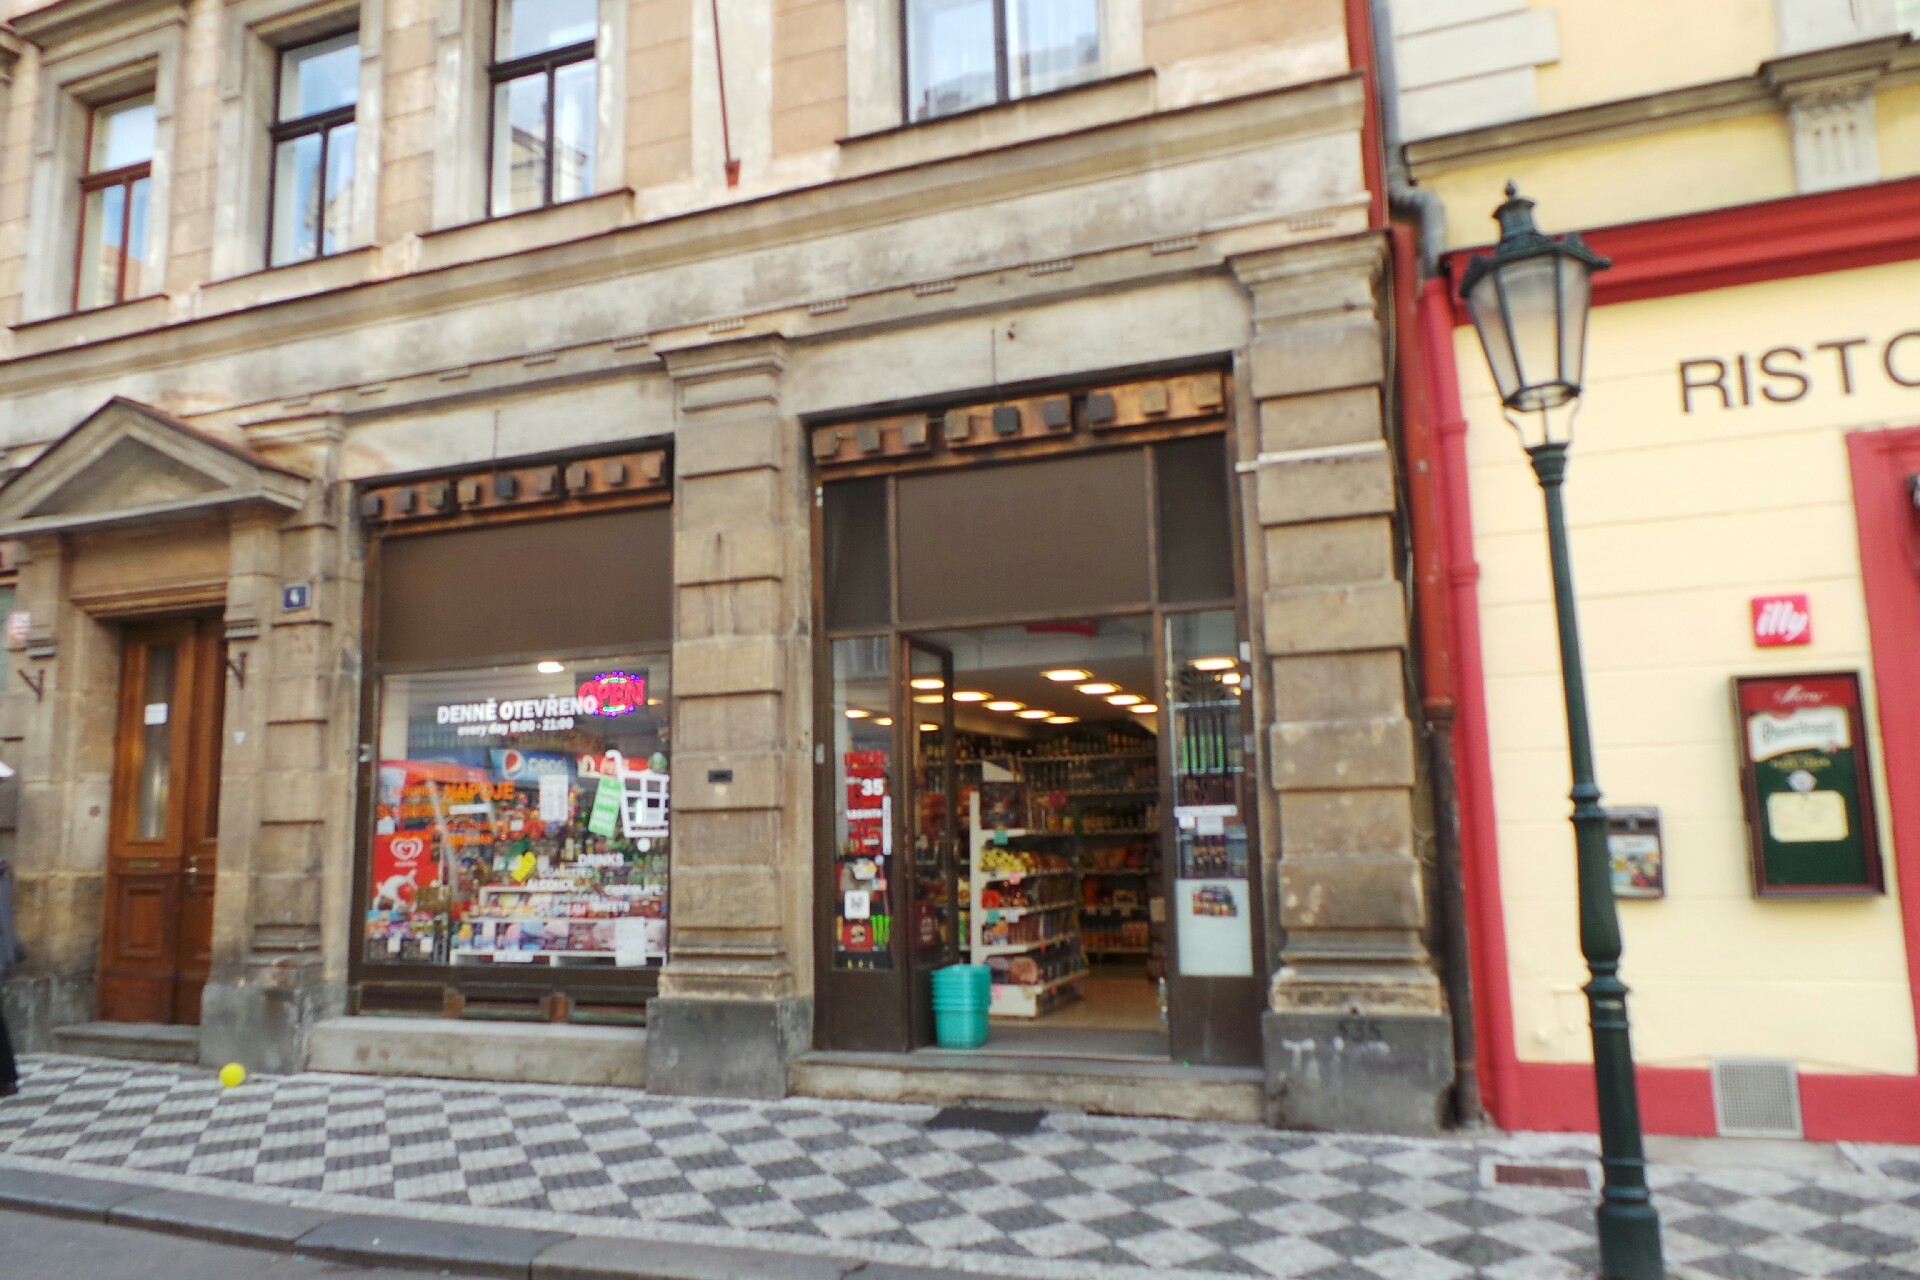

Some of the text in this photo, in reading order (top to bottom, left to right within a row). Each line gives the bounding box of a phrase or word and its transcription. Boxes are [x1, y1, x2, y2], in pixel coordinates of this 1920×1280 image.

[1756, 600, 1807, 641] illy
[437, 694, 598, 724] DENNĚ OTEVŘENO
[578, 679, 645, 713] OPEN
[861, 778, 884, 796] 35
